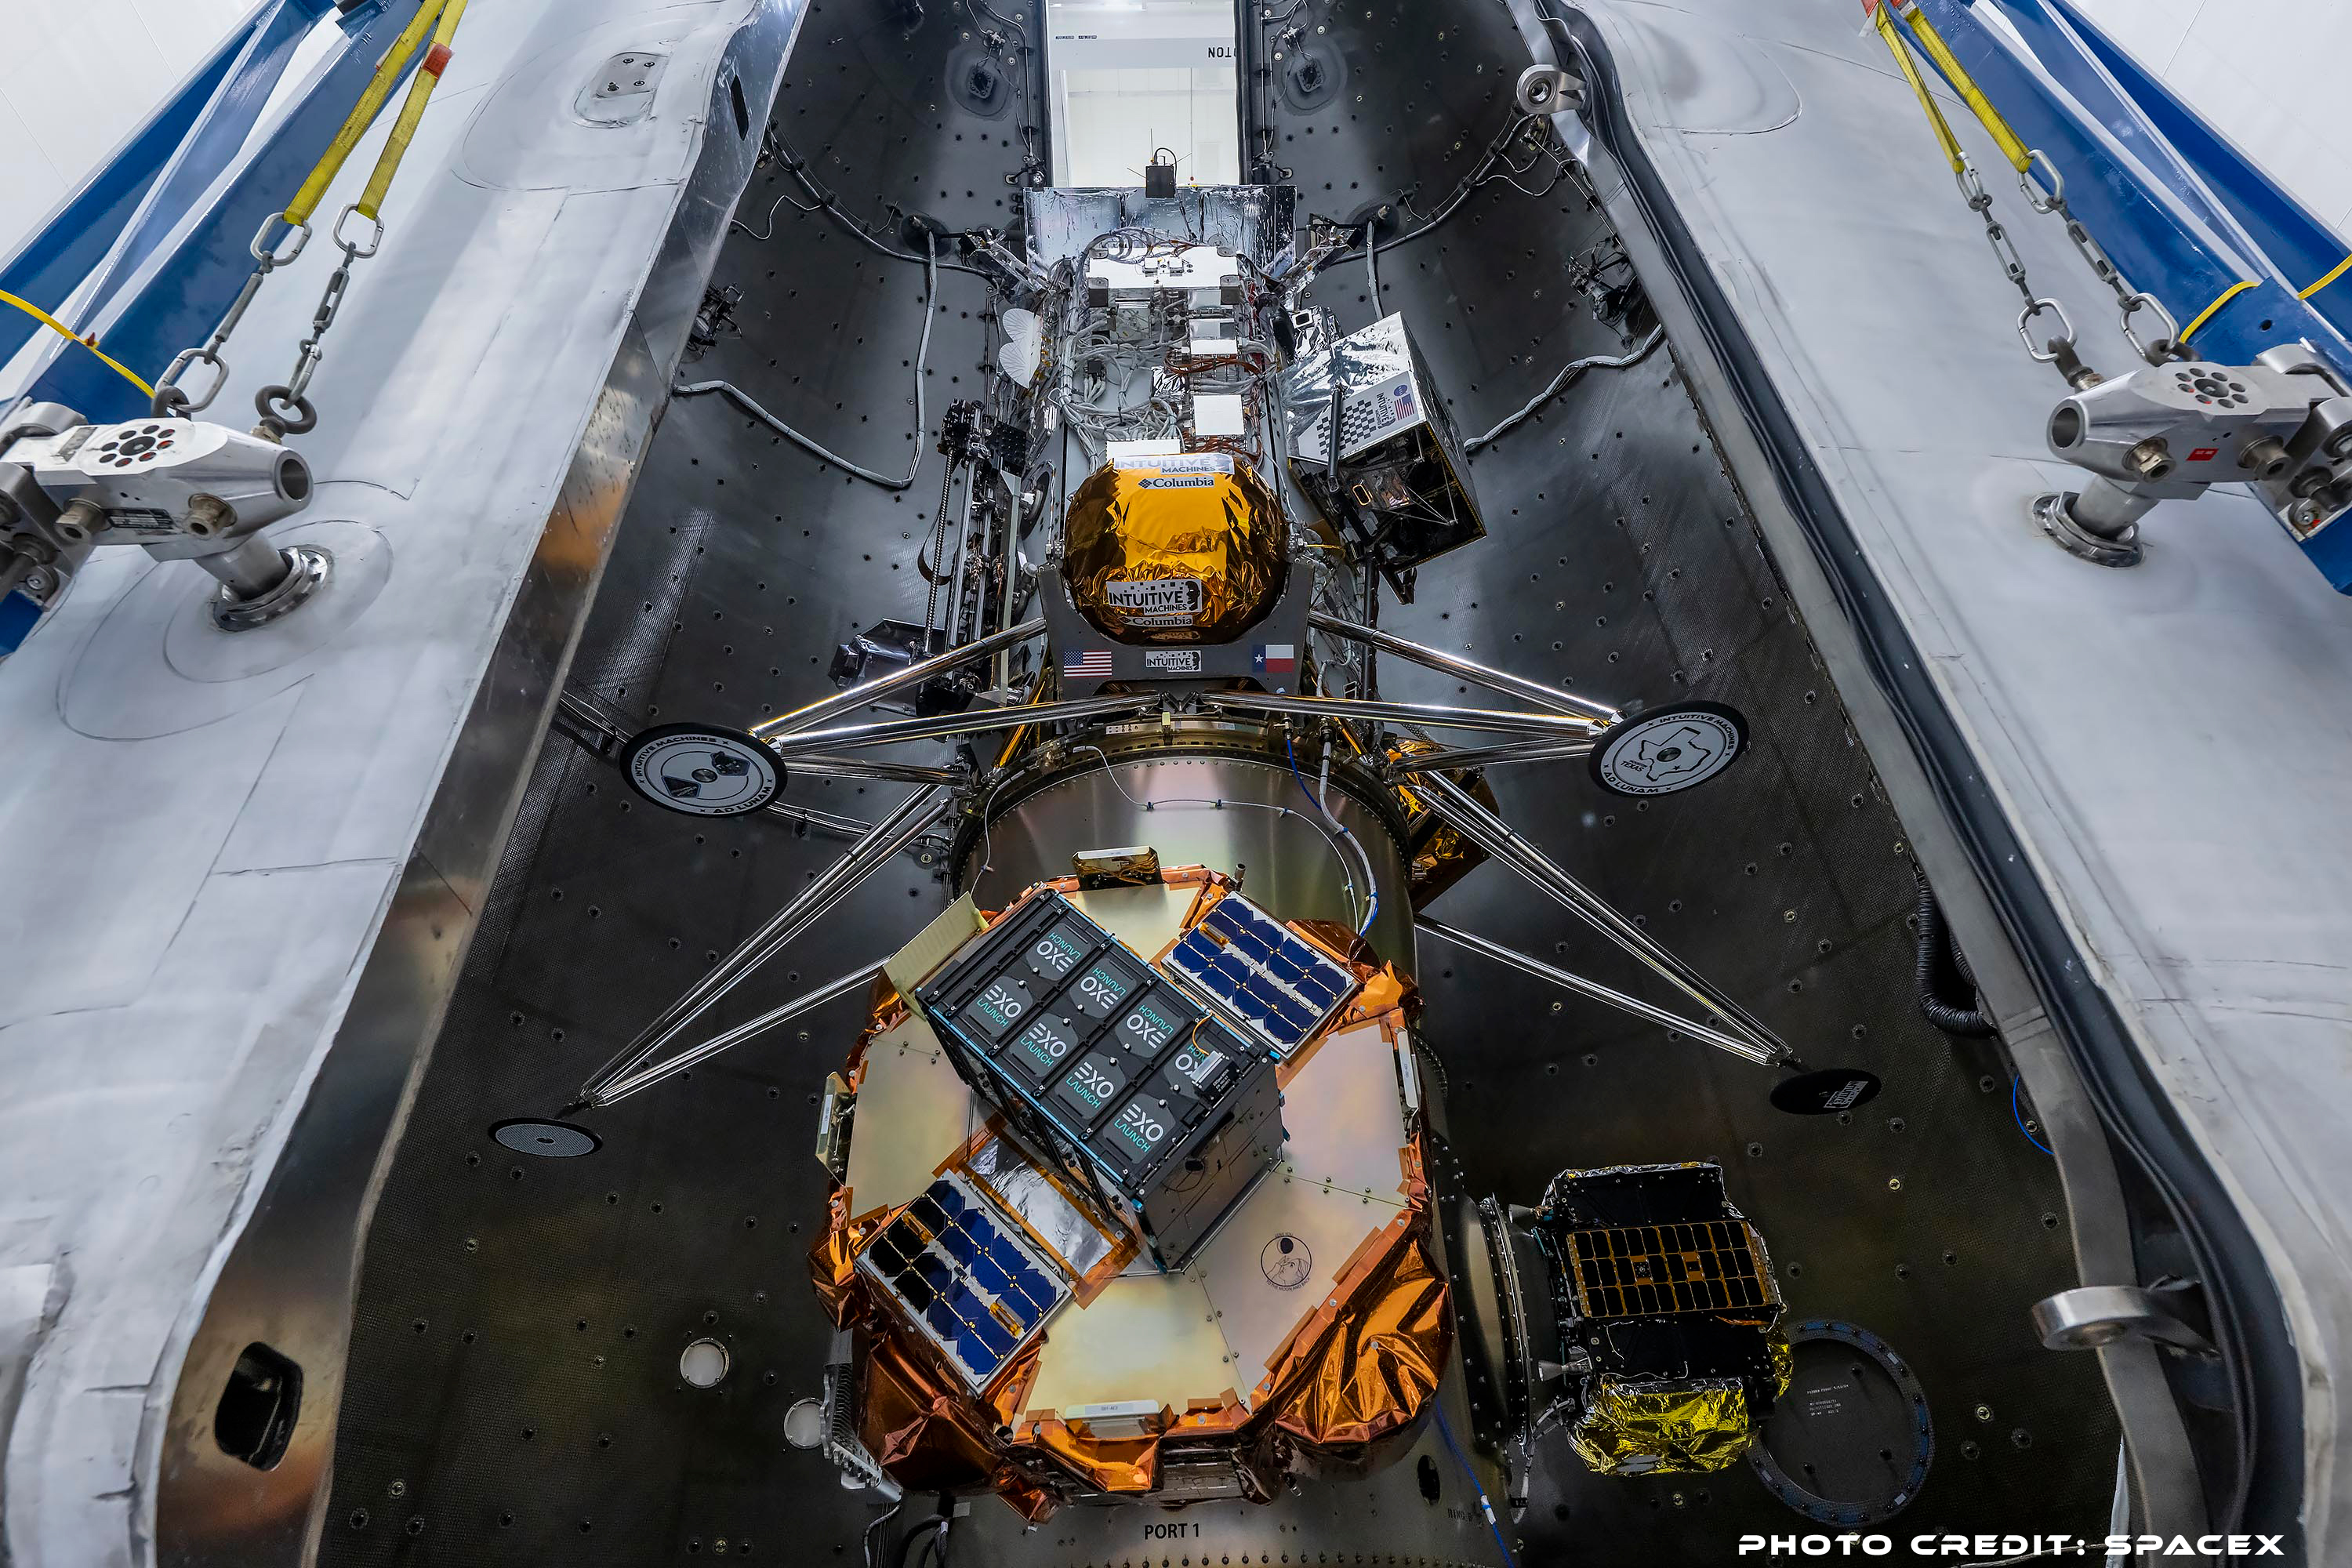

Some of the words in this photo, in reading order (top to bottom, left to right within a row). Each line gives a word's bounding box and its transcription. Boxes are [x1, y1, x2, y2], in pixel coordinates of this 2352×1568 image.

[1114, 457, 1210, 469] INTUITIVE
[1152, 477, 1214, 488] Columbia
[1109, 590, 1184, 607] INTUITIVE
[1145, 604, 1187, 613] MACHINES
[1132, 616, 1192, 626] Columbia
[1146, 658, 1191, 666] INTUITIVE
[1659, 713, 1715, 724] INTUITIVE
[1715, 719, 1737, 750] MACHINES
[635, 745, 657, 777] INTUITIVE
[656, 735, 717, 748] MACHINES
[1621, 760, 1645, 772] TEXAS
[1603, 771, 1617, 783] AD
[1615, 782, 1659, 793] LUNAM
[735, 786, 773, 811] LUNAM
[1036, 940, 1074, 973] EXO
[1048, 931, 1082, 960] LAUNCH
[1080, 976, 1120, 1010] EXO
[1092, 967, 1127, 996] LAUNCH
[976, 997, 1009, 1028] LAUNCH
[984, 984, 1022, 1018] EXO
[1127, 1014, 1167, 1049] EXO
[1138, 1004, 1174, 1035] LAUNCH
[1020, 1036, 1054, 1067] LAUNCH
[1028, 1022, 1067, 1058] EXO
[1066, 1076, 1102, 1109] LAUNCH
[1074, 1062, 1114, 1098] EXO
[1114, 1118, 1152, 1152] LAUNCH
[1122, 1103, 1164, 1142] EXO
[1145, 1523, 1188, 1540] PORT
[1192, 1523, 1200, 1537] 1
